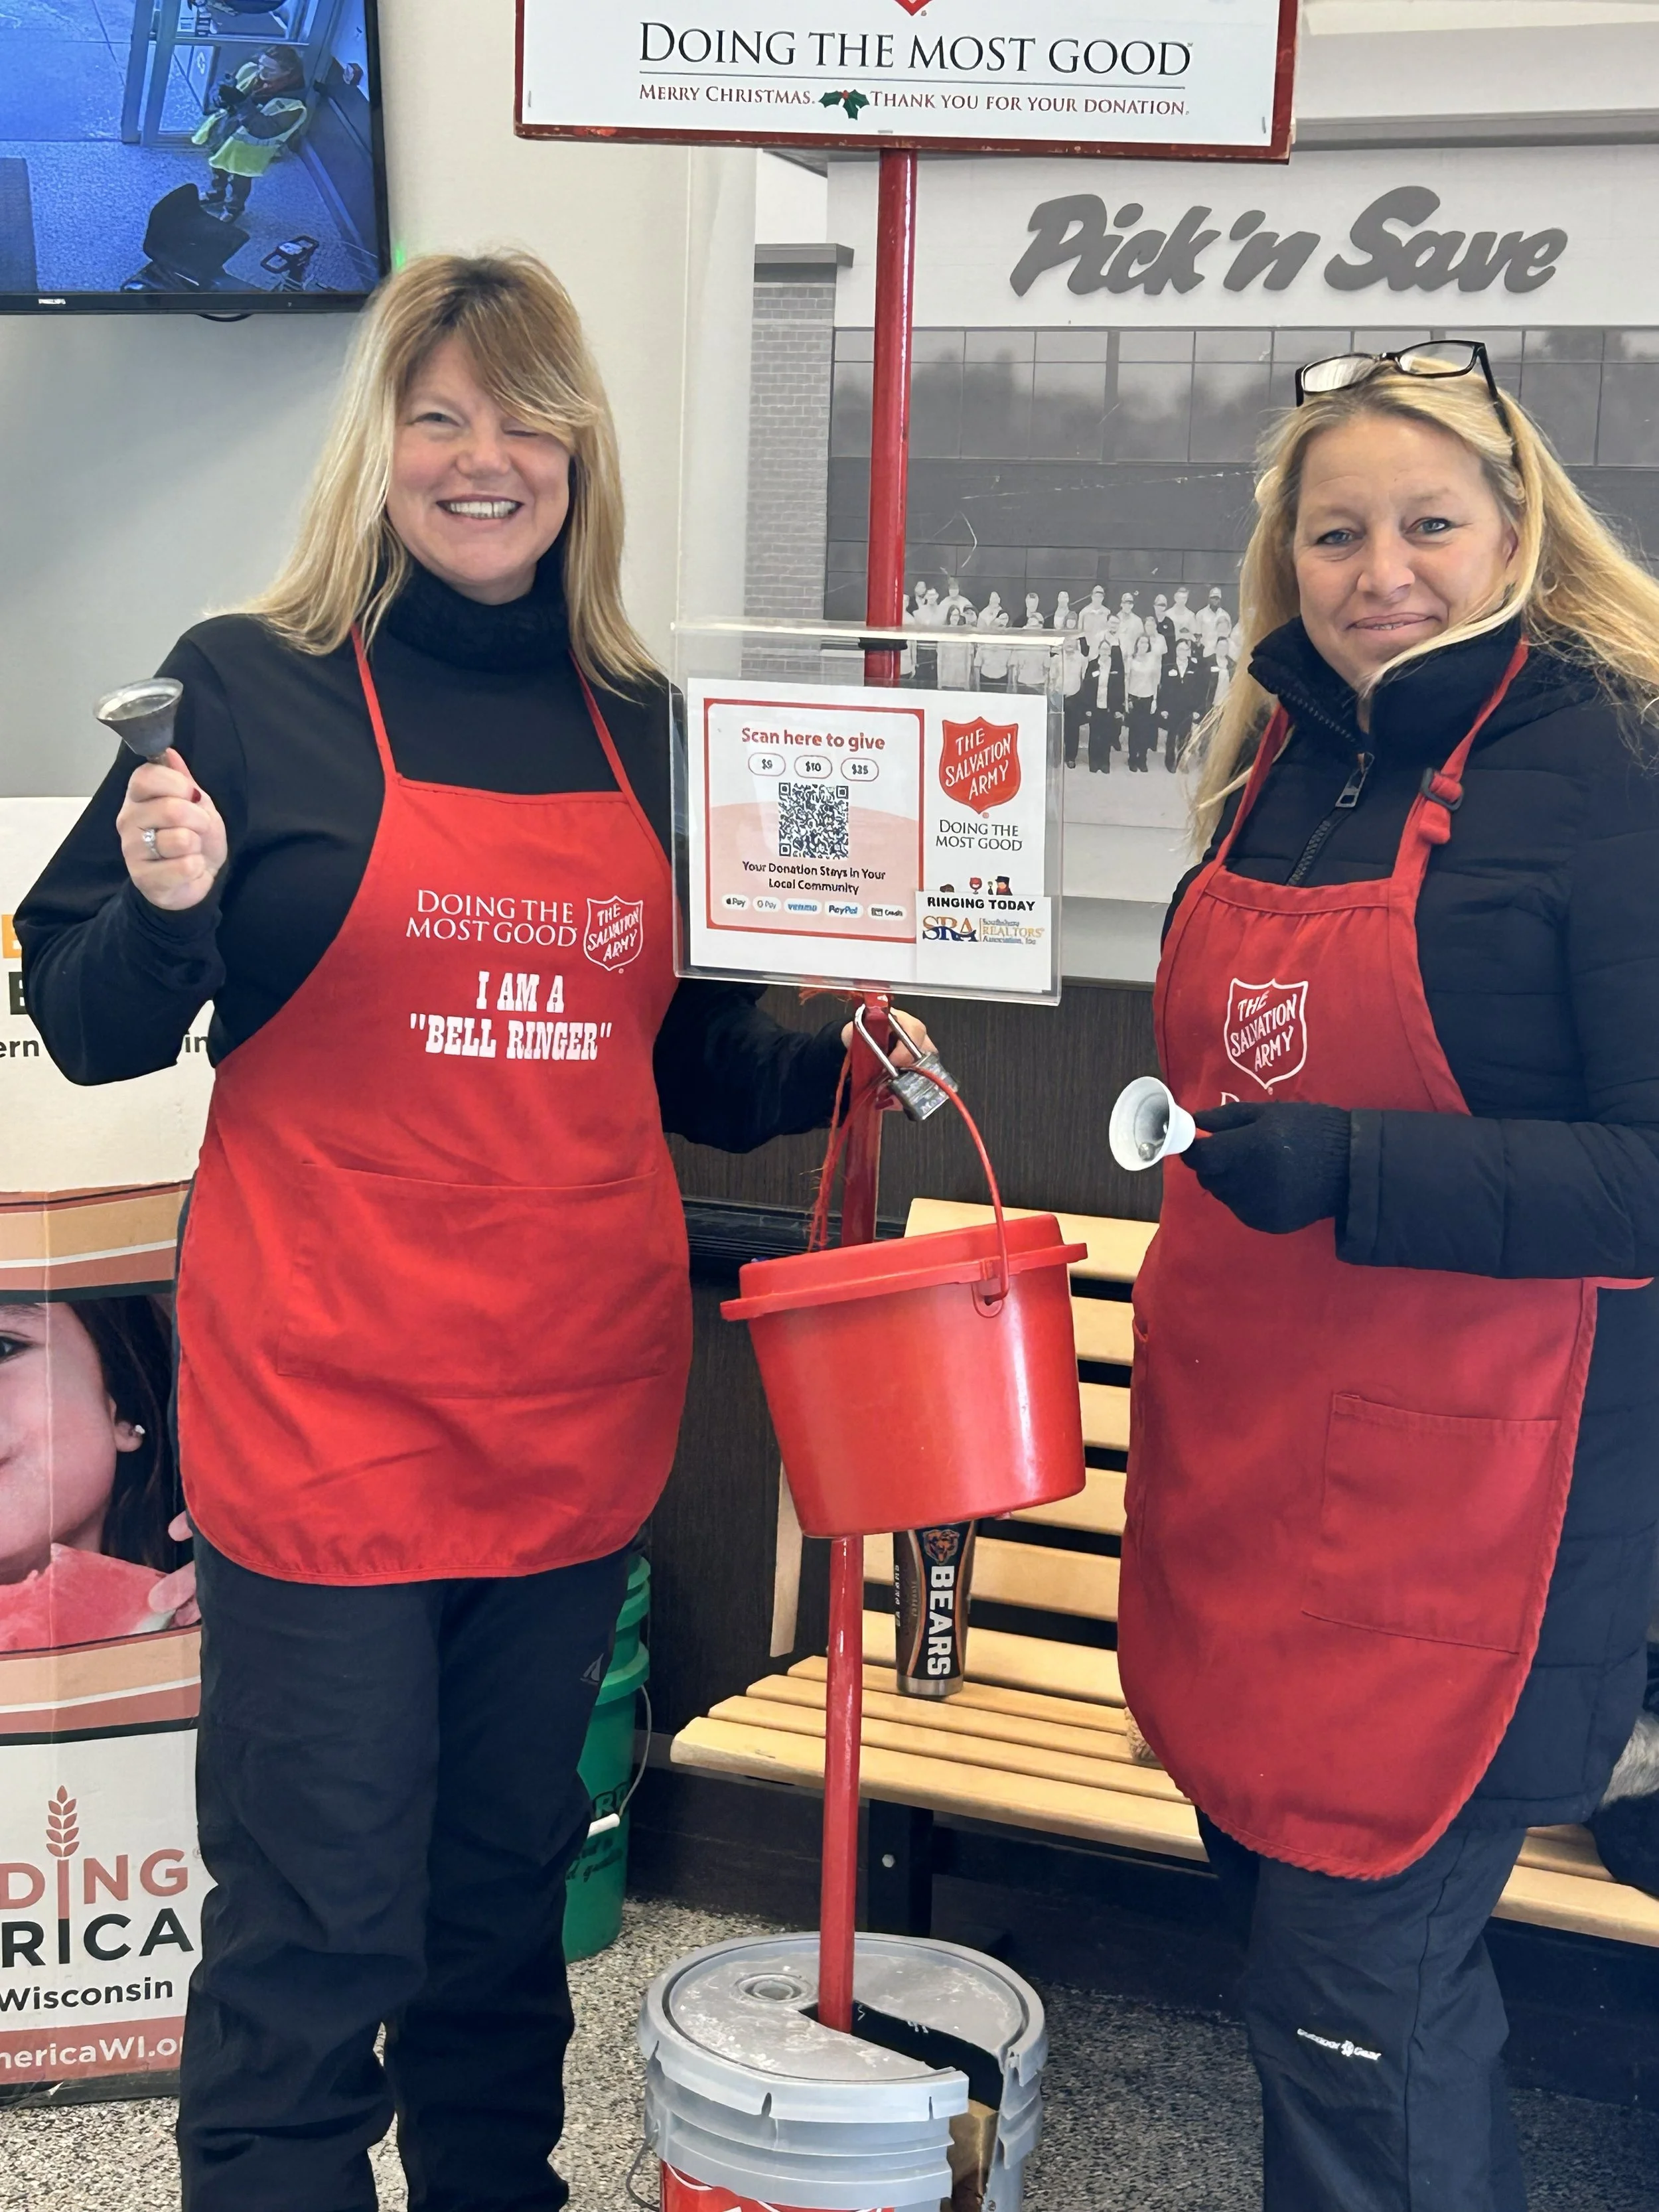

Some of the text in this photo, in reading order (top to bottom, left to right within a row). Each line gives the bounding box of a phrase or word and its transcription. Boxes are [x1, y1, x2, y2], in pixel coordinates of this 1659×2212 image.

[640, 22, 1190, 75] DOING THE MOST GOOD
[640, 84, 816, 104] MERRY CHRISTMAS.
[870, 91, 1189, 115] THANK YOU FOR YOUR DONATION.
[1325, 186, 1567, 293] Save
[742, 727, 885, 752] Scan here to give
[956, 728, 985, 755] THE
[806, 761, 822, 771] $10
[946, 733, 1011, 786] SALVATION
[969, 760, 1008, 800] ARMY
[936, 836, 1023, 851] MOST GOOD
[940, 820, 1018, 836] DOING THE
[743, 861, 766, 872] Your
[768, 863, 818, 875] Donation
[820, 866, 847, 879] Stays
[861, 869, 885, 880] Your
[768, 879, 859, 895] Local Community
[417, 890, 573, 924] DOING THE
[597, 903, 621, 926] THE
[829, 905, 857, 915] PayPal
[928, 897, 1035, 911] RINGING TODAY
[406, 917, 576, 947] MOST GOOD
[587, 907, 639, 951] SALVATION
[603, 929, 638, 962] ARMY
[476, 971, 565, 1013] I AM A
[1238, 990, 1270, 1021] THE
[1230, 994, 1297, 1057] SALVATION
[1255, 1025, 1294, 1072] ARMY
[927, 1566, 955, 1675] BEARS
[0, 1976, 173, 2012] Wisconsin
[0, 2036, 183, 2069] ericaWI.o
